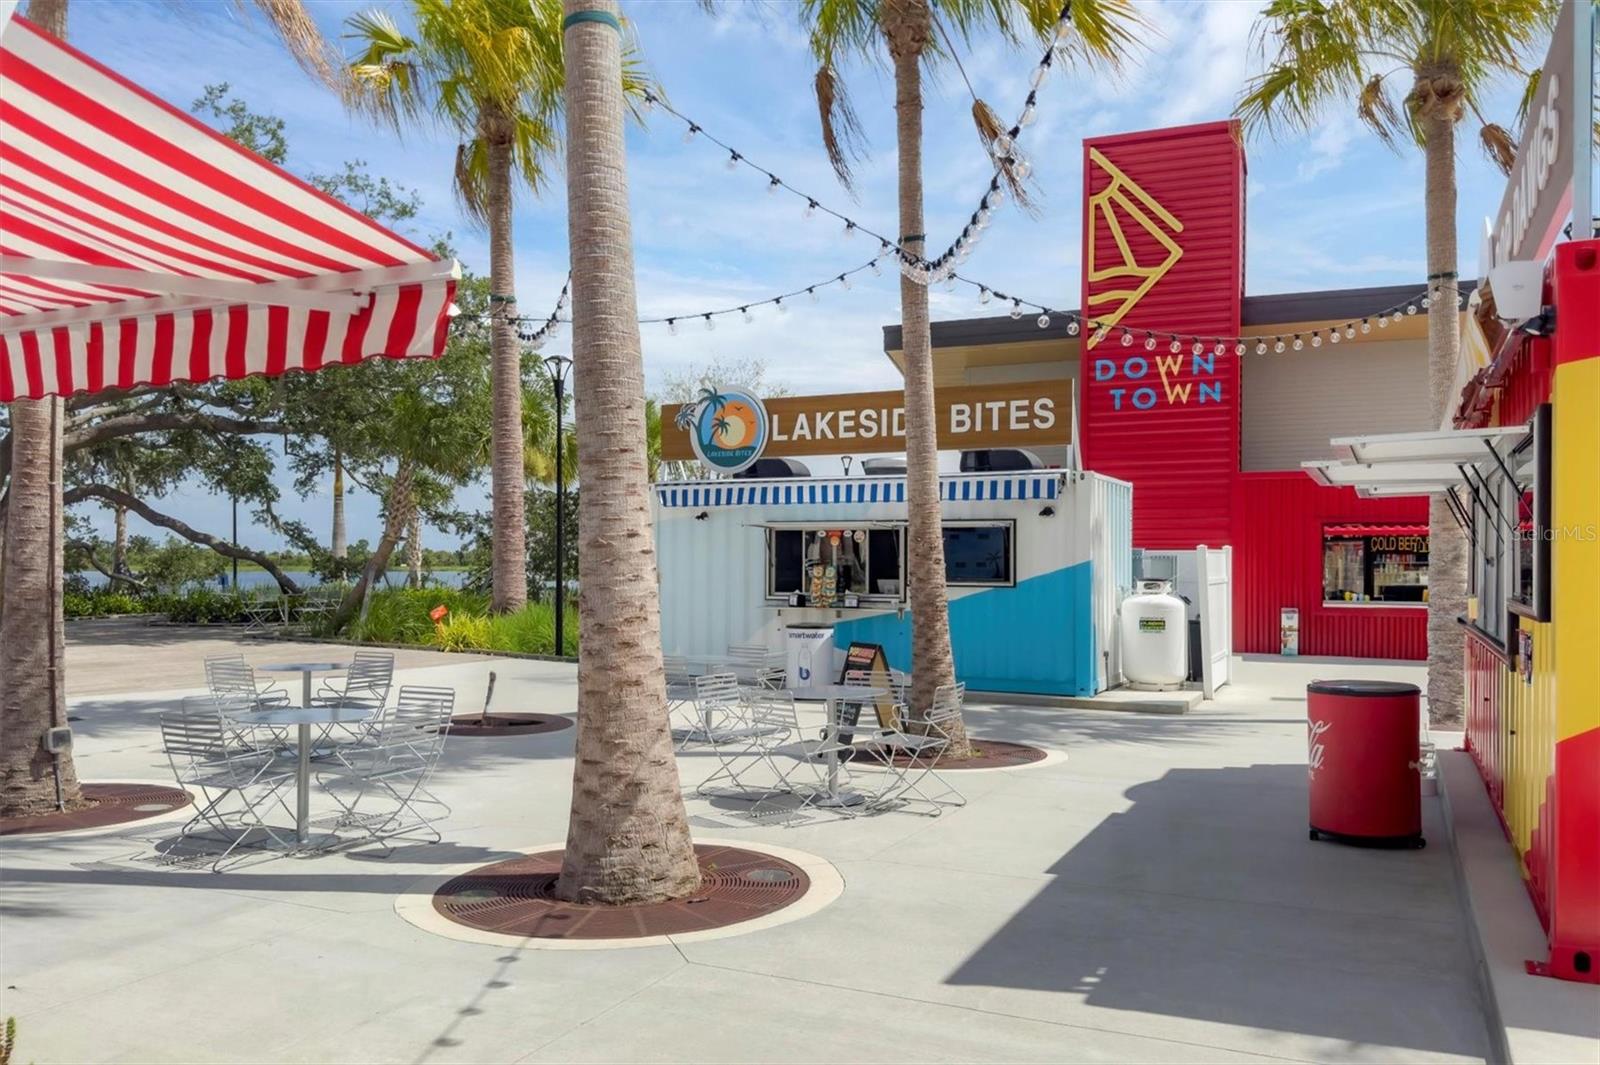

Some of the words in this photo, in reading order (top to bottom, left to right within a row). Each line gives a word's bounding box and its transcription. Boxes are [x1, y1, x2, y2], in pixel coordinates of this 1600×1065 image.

[1513, 74, 1560, 257] DAWGS
[1095, 353, 1214, 381] DOWN
[1110, 381, 1221, 410] TOWN
[772, 408, 906, 441] LAKESID
[950, 397, 1056, 434] BITES
[1371, 536, 1397, 551] COLD
